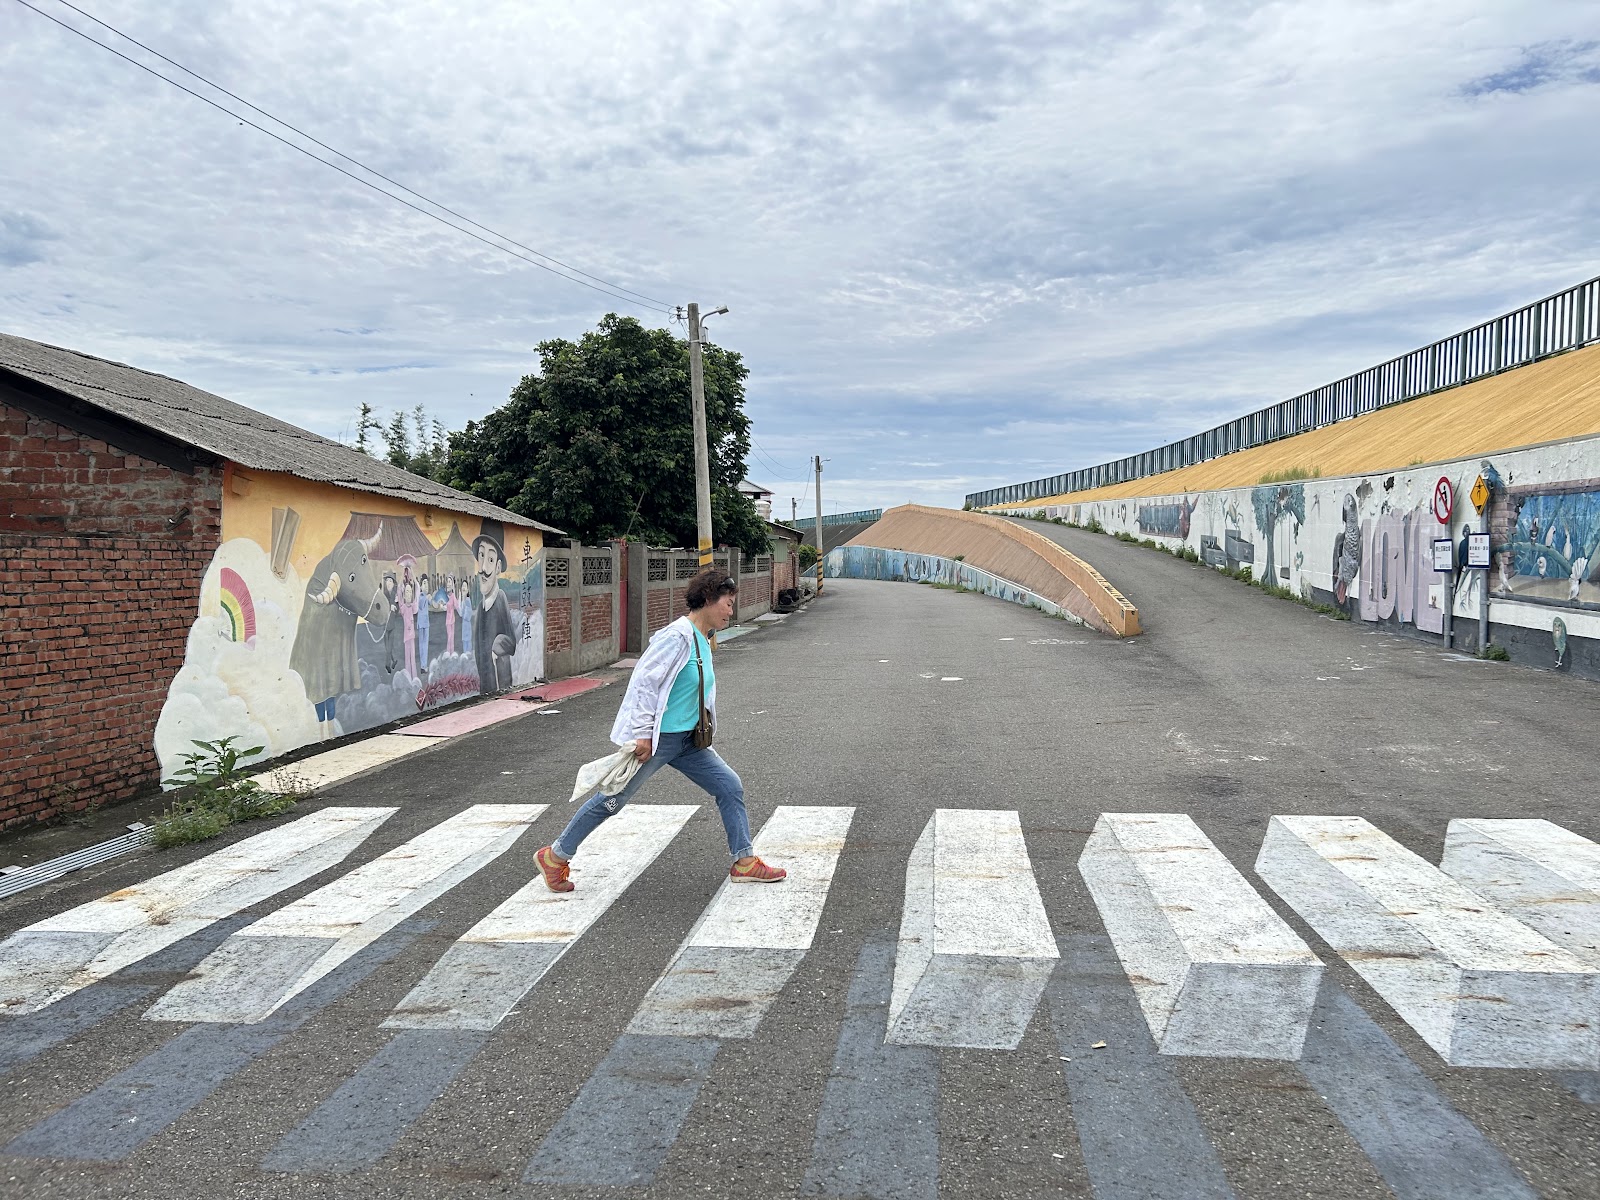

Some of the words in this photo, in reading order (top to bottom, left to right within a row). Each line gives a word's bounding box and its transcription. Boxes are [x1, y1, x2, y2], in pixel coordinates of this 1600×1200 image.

[520, 536, 533, 647] 車鼓陣
[1359, 508, 1443, 634] LOVE
